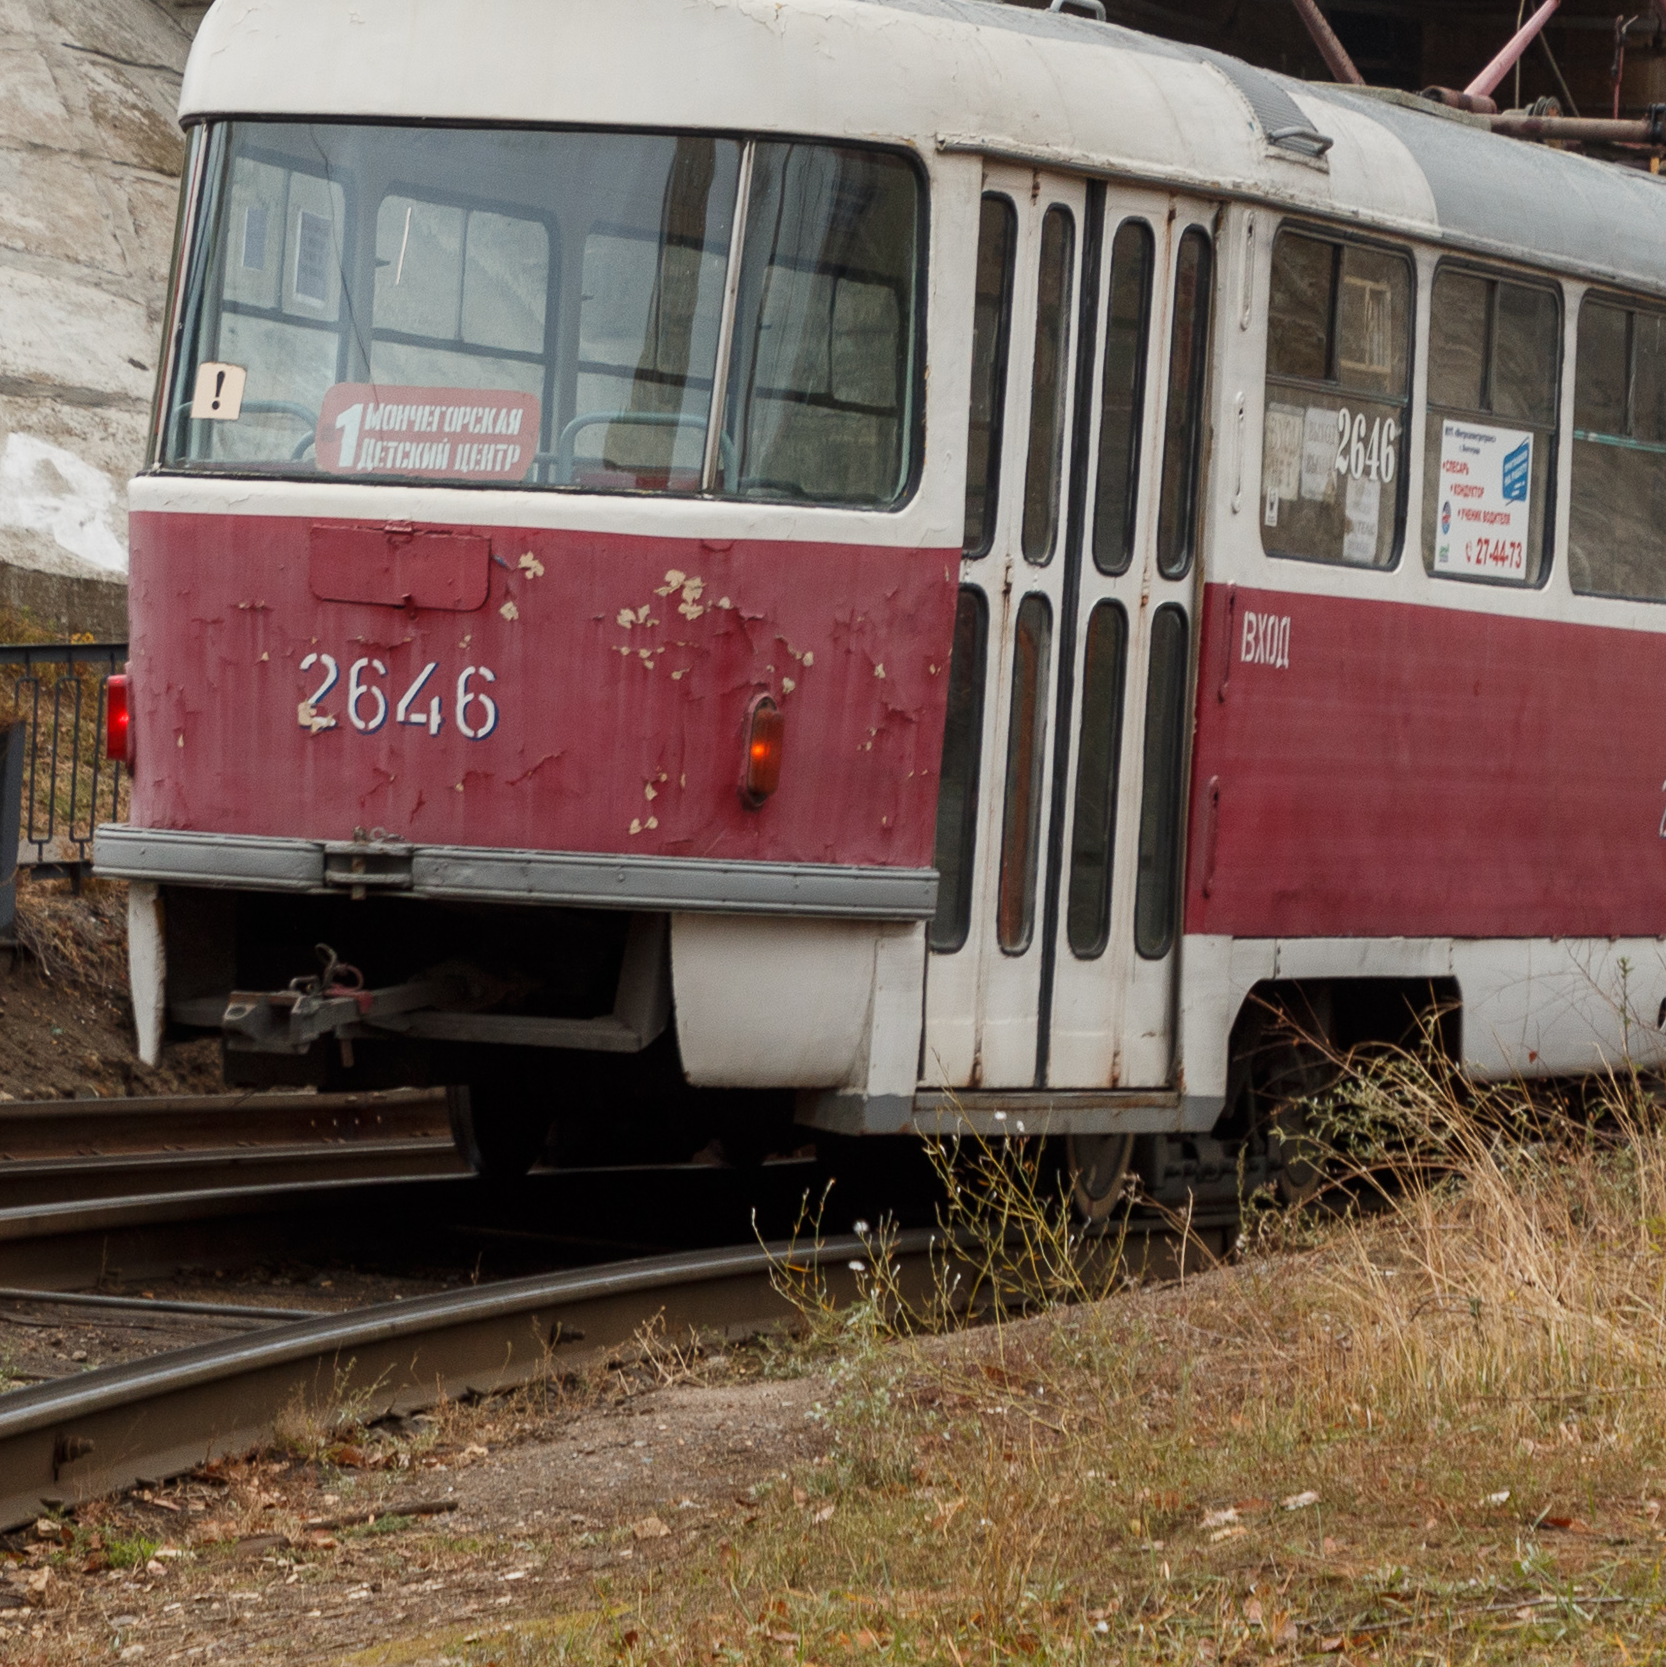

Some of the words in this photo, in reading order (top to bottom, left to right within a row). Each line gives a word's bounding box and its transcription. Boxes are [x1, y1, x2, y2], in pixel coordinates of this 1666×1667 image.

[335, 403, 364, 467] 1
[364, 403, 524, 435] МОНЧЕГОРСКАЯ
[357, 437, 451, 471] ДЕТСКИЙ
[454, 443, 521, 473] ЦЕНТР
[1335, 407, 1395, 483] 2646
[1476, 537, 1522, 569] 27-44-73
[1241, 610, 1291, 669] ВХОД
[298, 652, 499, 739] 2646
